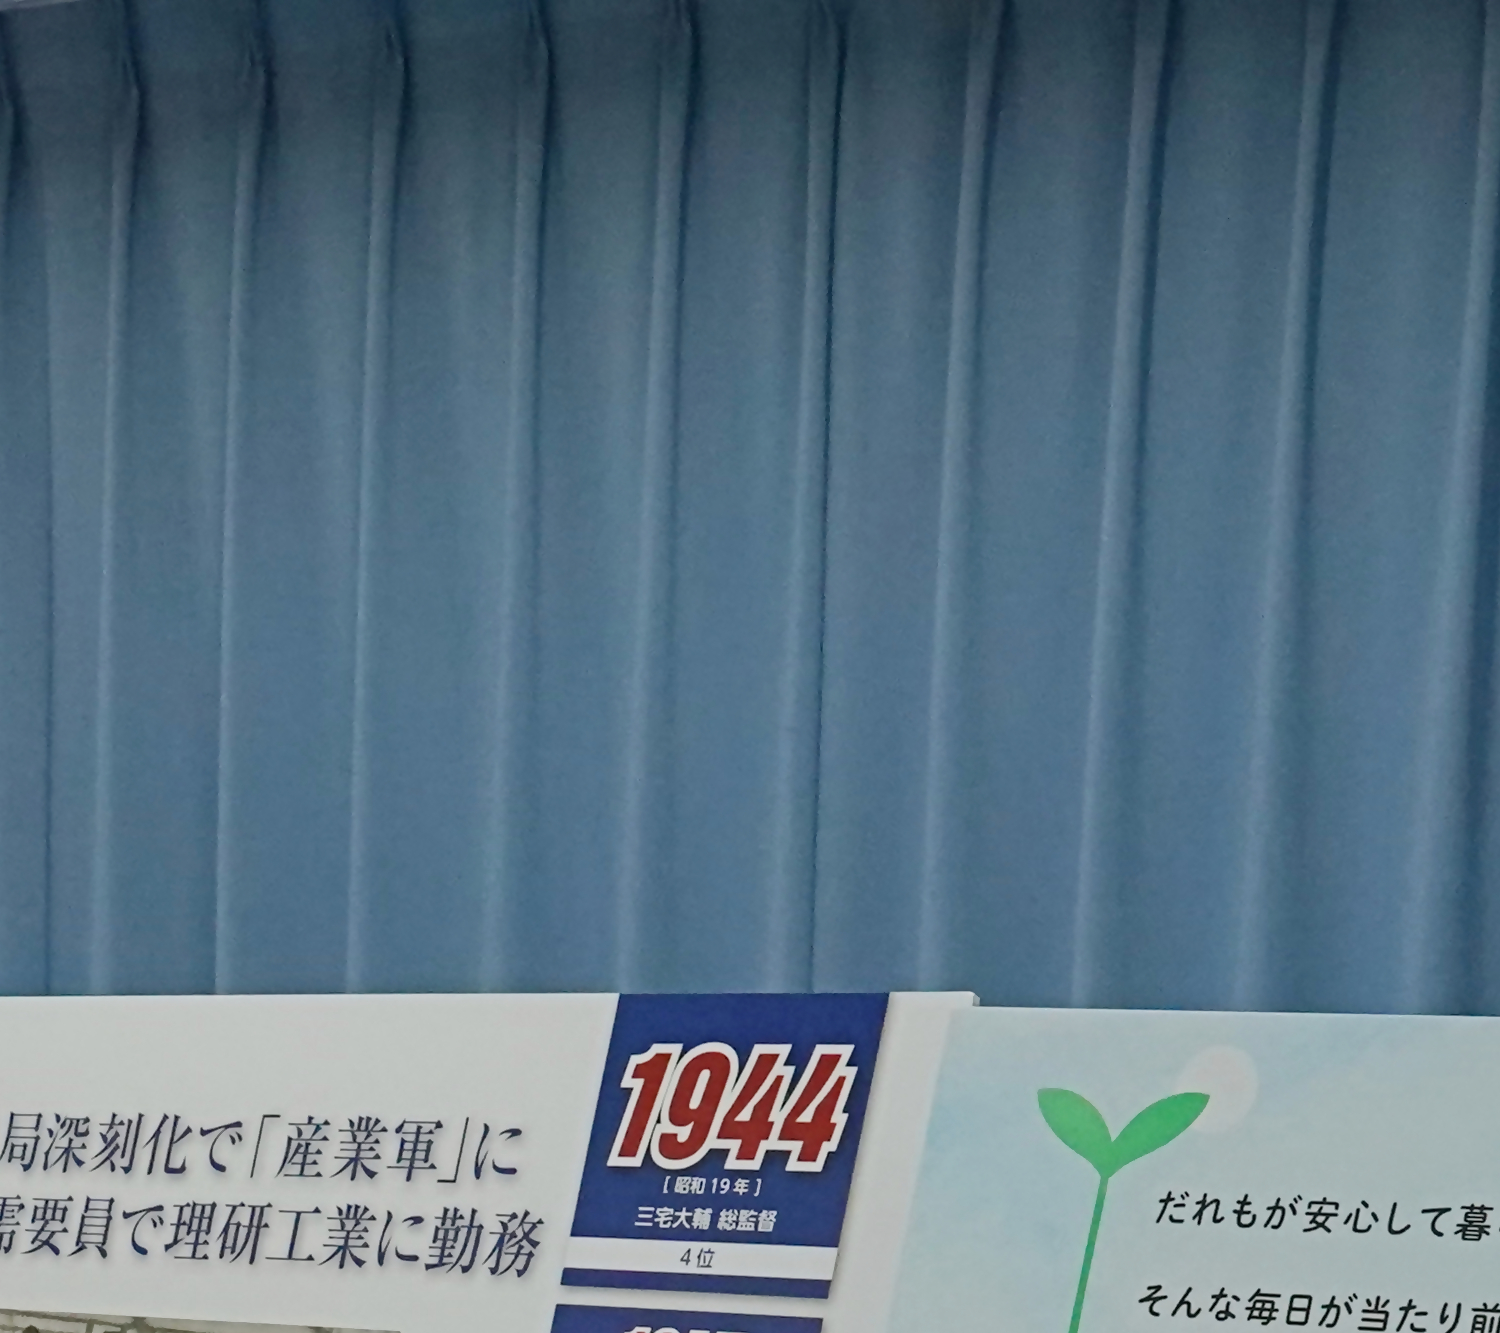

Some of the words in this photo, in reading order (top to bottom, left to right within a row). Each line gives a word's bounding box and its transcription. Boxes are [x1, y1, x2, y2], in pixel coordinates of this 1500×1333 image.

[607, 1042, 858, 1172] 1944
[634, 1206, 710, 1230] 三宅大輔
[716, 1208, 778, 1233] 総監督
[680, 1247, 714, 1270] 4位
